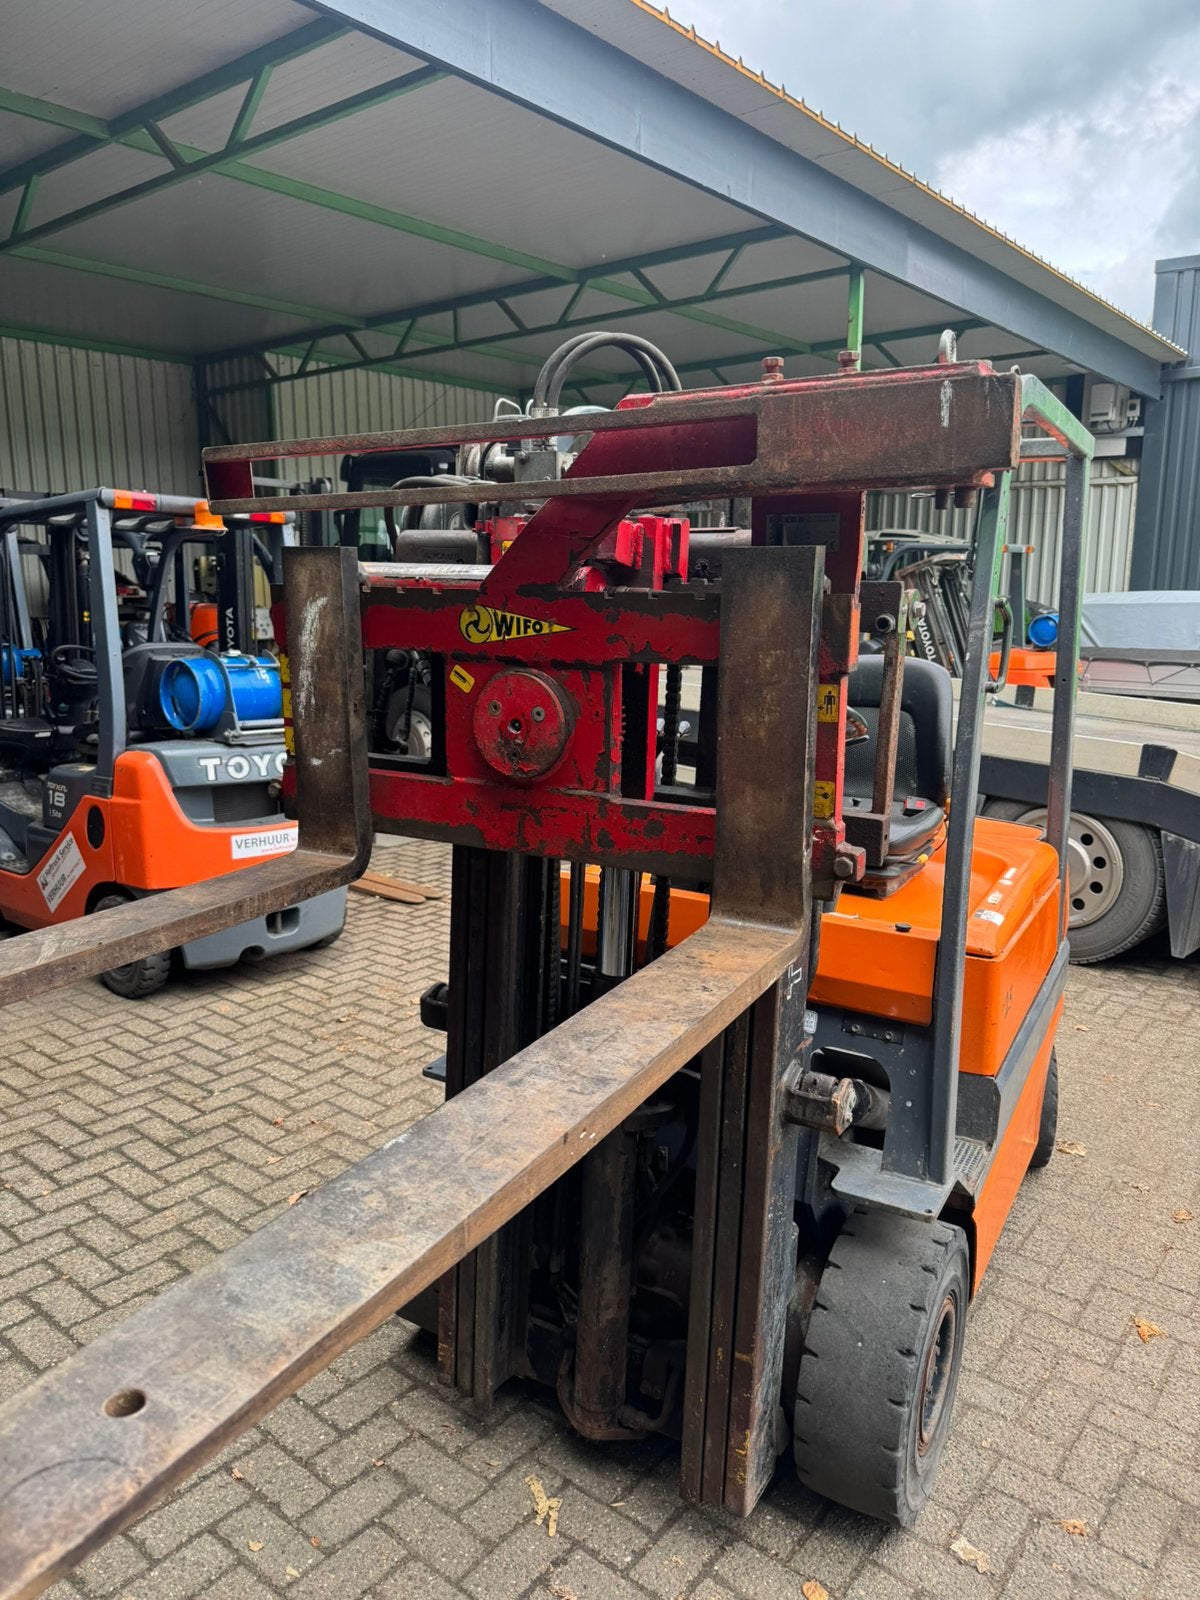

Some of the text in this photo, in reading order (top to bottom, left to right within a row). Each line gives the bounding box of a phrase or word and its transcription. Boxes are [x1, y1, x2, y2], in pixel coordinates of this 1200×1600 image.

[226, 607, 235, 647] YOTA
[494, 613, 543, 637] WIFO
[917, 617, 936, 662] TOYOTA
[48, 790, 65, 807] 18
[59, 837, 74, 860] Service
[235, 833, 290, 854] VERHUUR
[47, 873, 67, 904] VERHUUR
